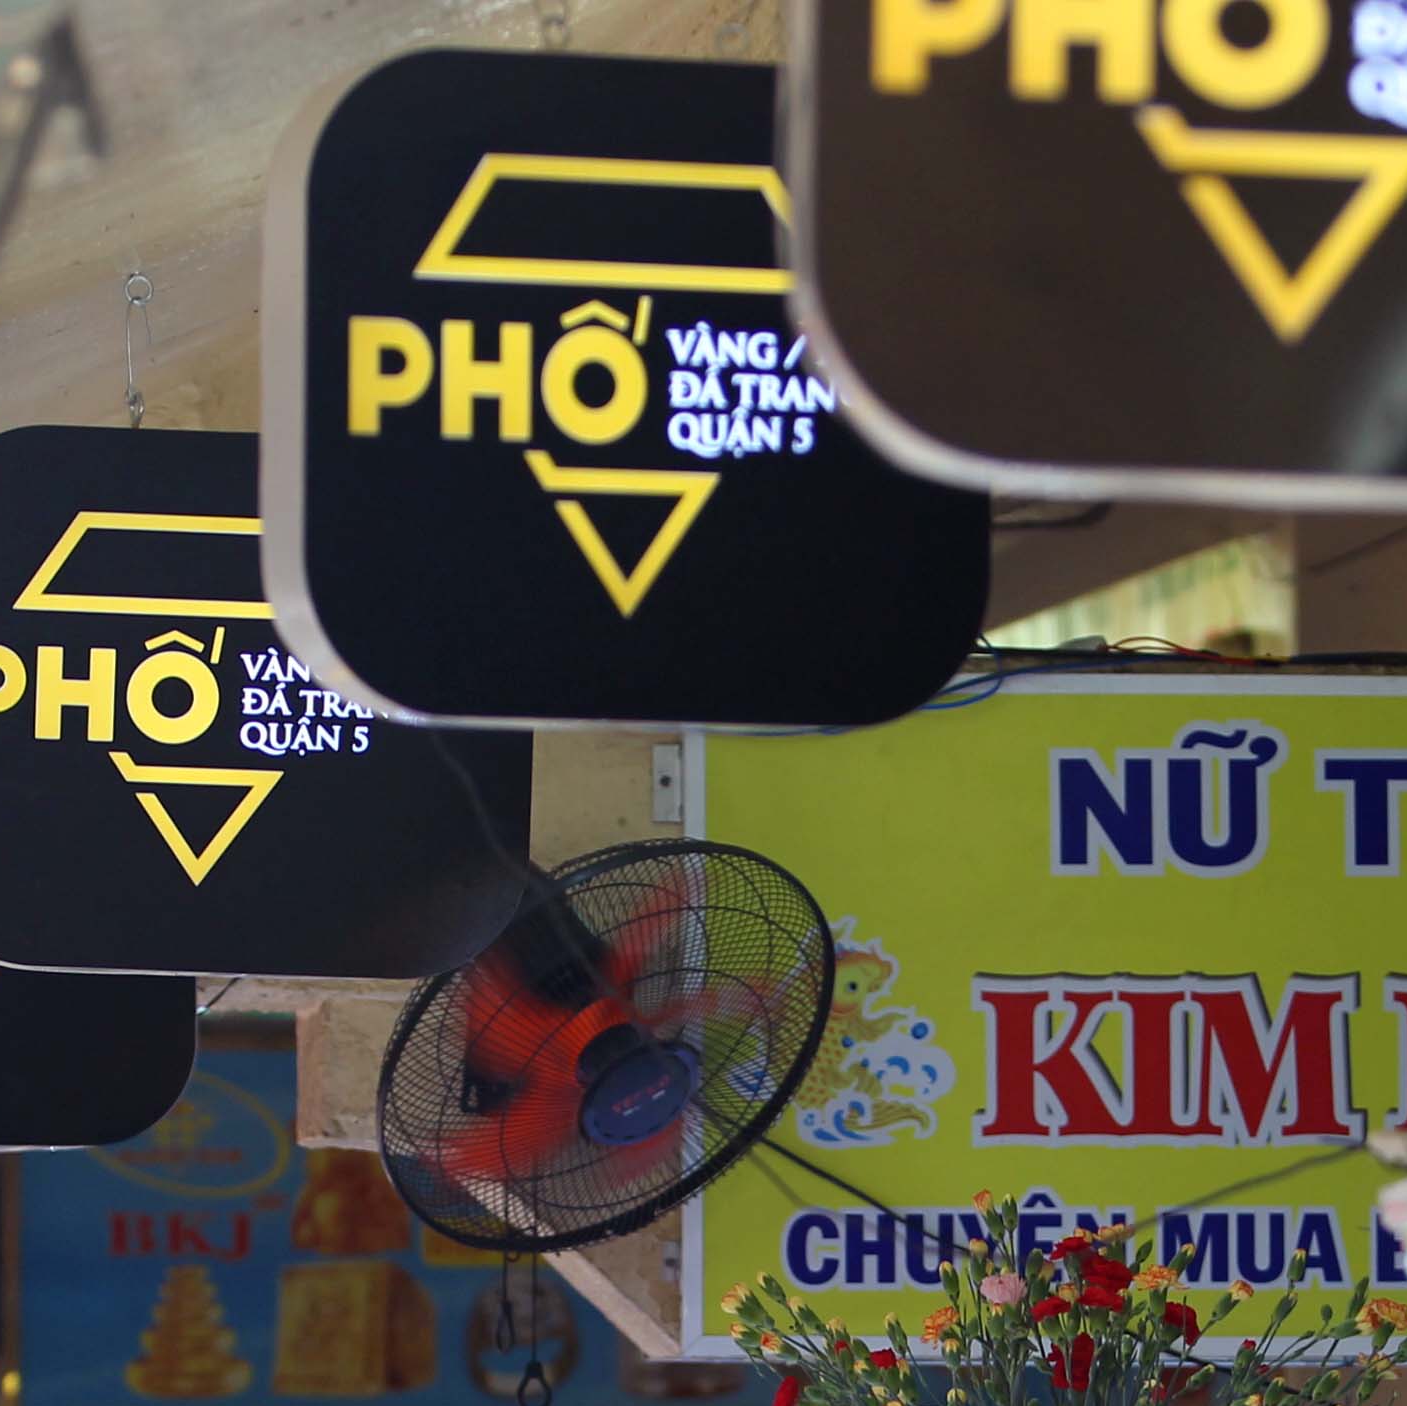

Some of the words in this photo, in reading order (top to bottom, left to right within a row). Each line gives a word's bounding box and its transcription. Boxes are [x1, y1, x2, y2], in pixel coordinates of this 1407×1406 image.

[348, 296, 651, 445] PHỐ
[665, 321, 778, 371] VÀNG
[668, 364, 729, 410] ĐÁ
[731, 373, 836, 414] TRAN
[667, 405, 782, 459] QUẬN
[791, 416, 815, 454] 5
[240, 647, 311, 683] VÀN
[241, 682, 293, 716] ĐÁ
[298, 689, 375, 719] TRA
[239, 716, 342, 757] QUẬN
[351, 725, 370, 753] 5
[1056, 727, 1281, 868] NỮ
[978, 985, 1354, 1140] KIM
[1160, 1213, 1343, 1283] MUA
